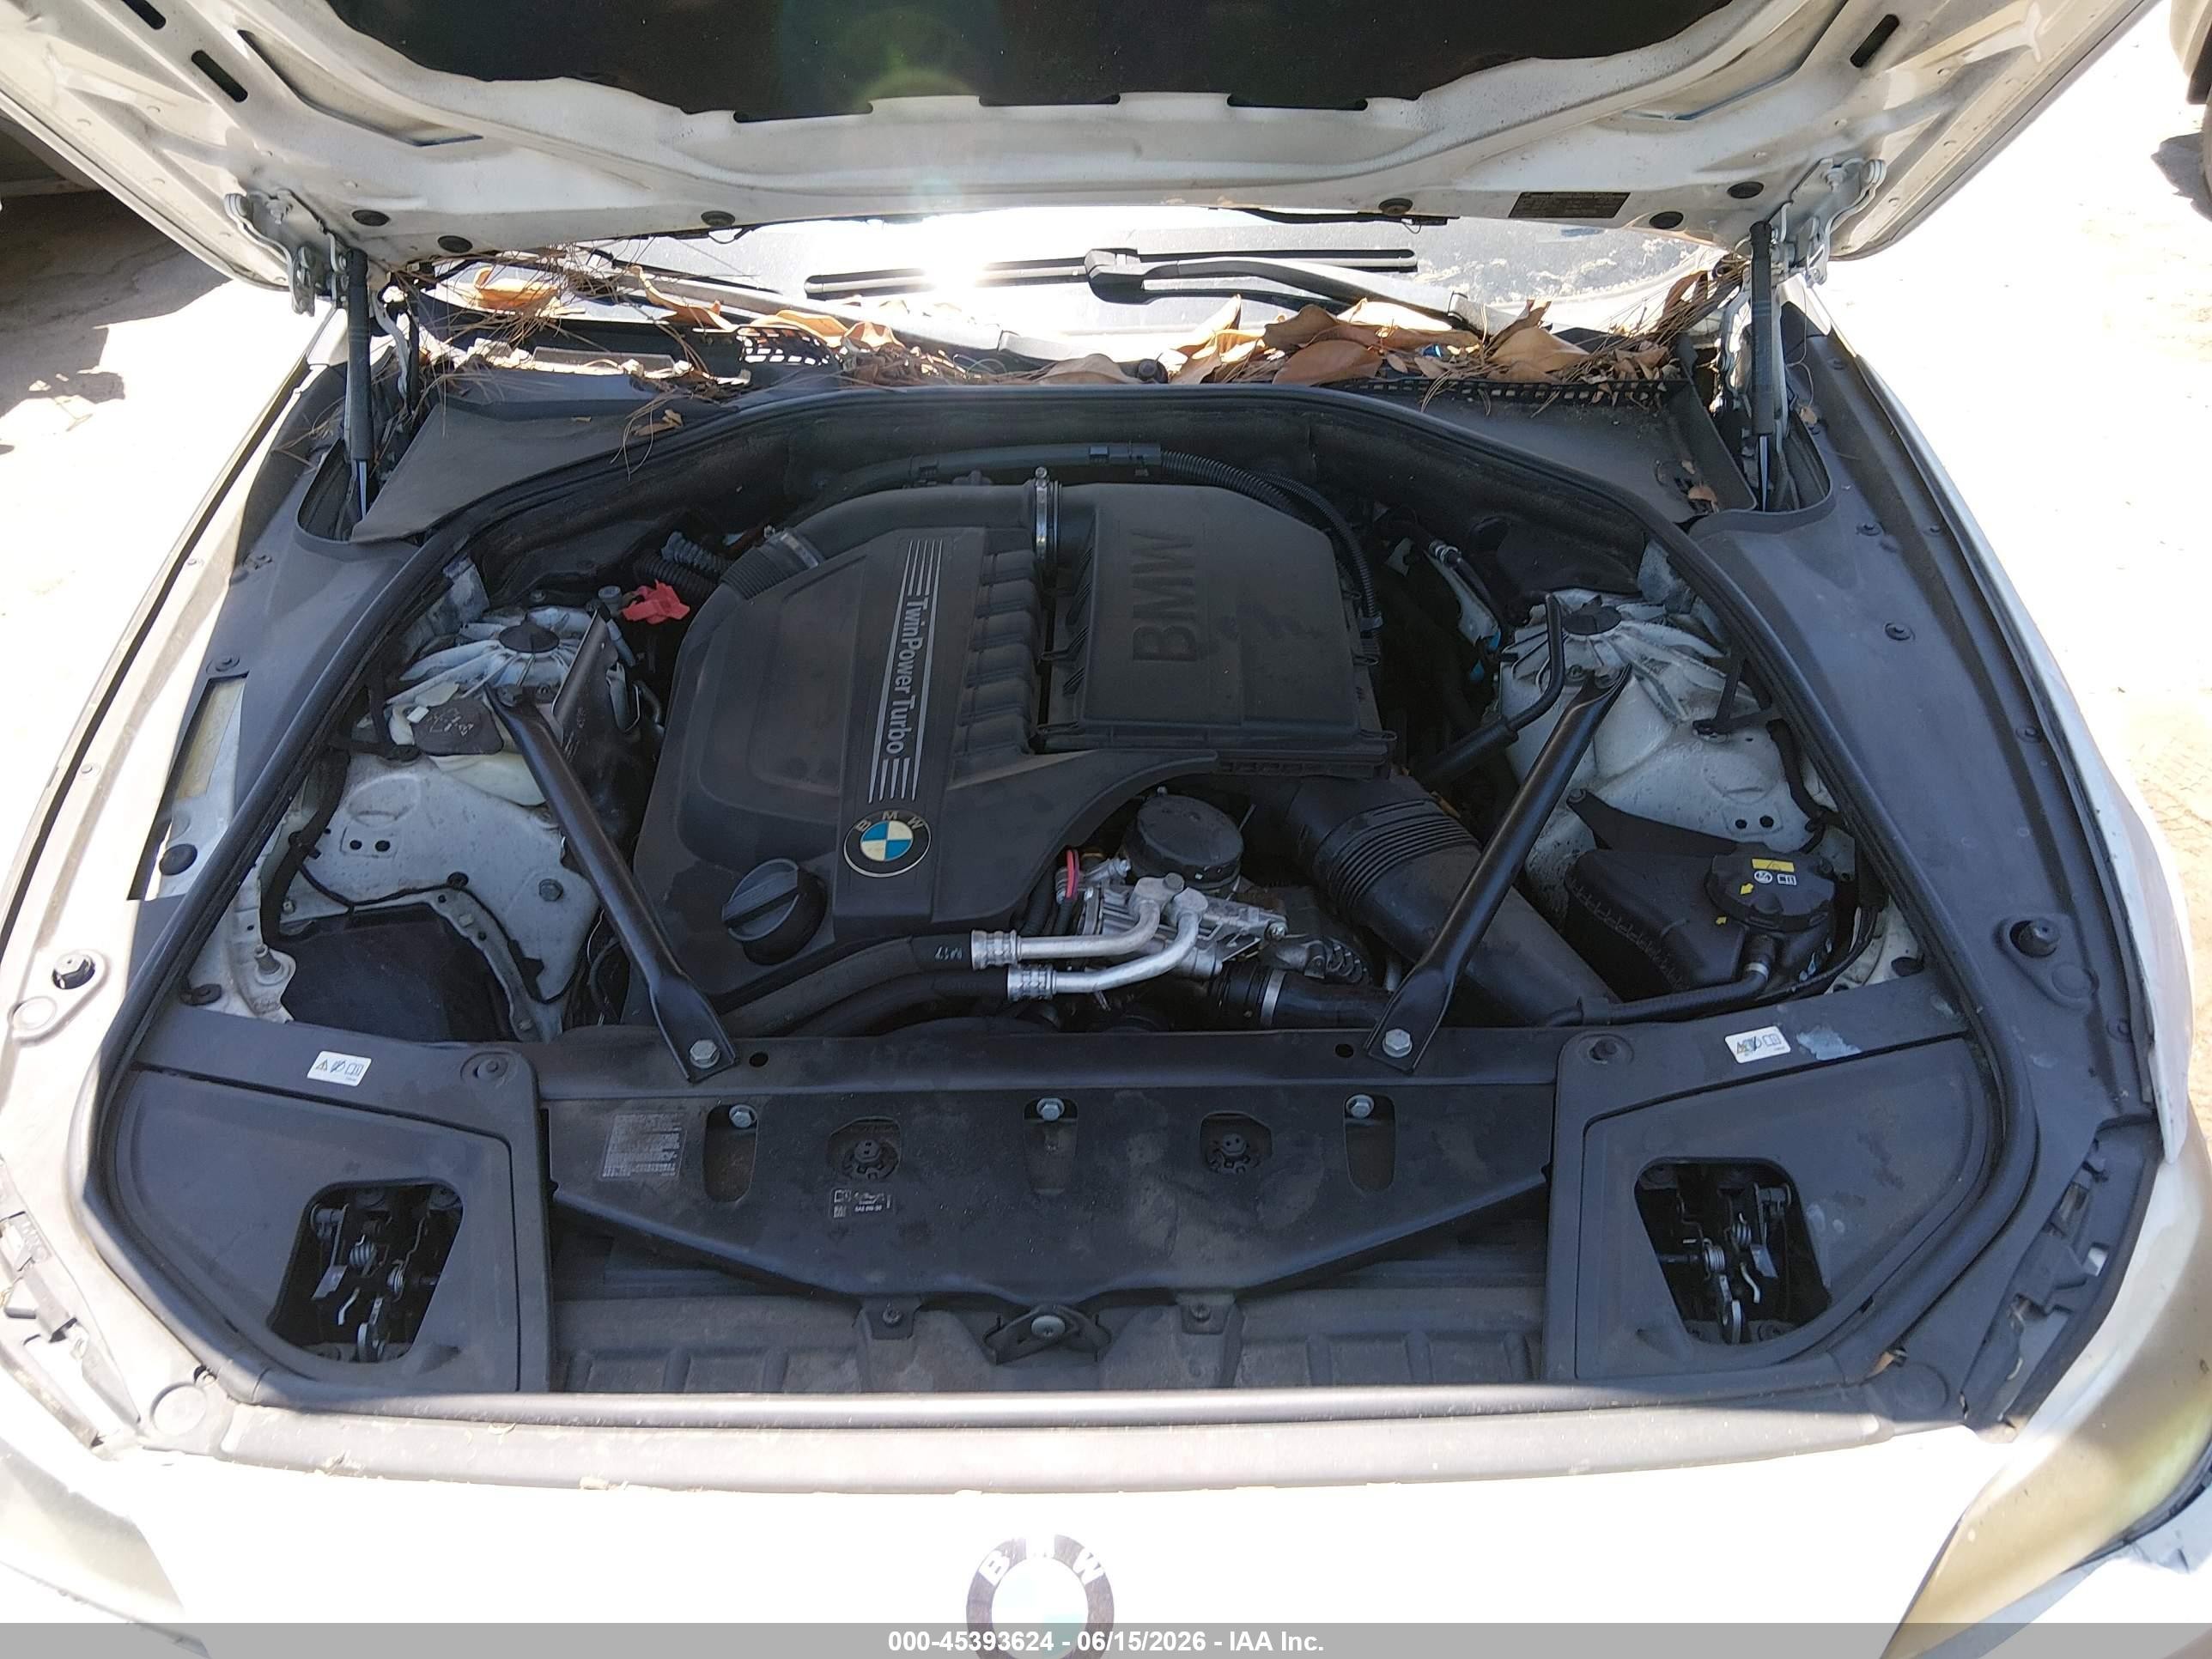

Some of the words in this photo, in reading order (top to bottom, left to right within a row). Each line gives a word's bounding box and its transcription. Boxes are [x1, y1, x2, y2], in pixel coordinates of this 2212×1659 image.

[1131, 529, 1197, 661] BMW
[895, 597, 928, 693] TwinPower
[886, 694, 916, 754] Turbo
[855, 811, 928, 832] BMW
